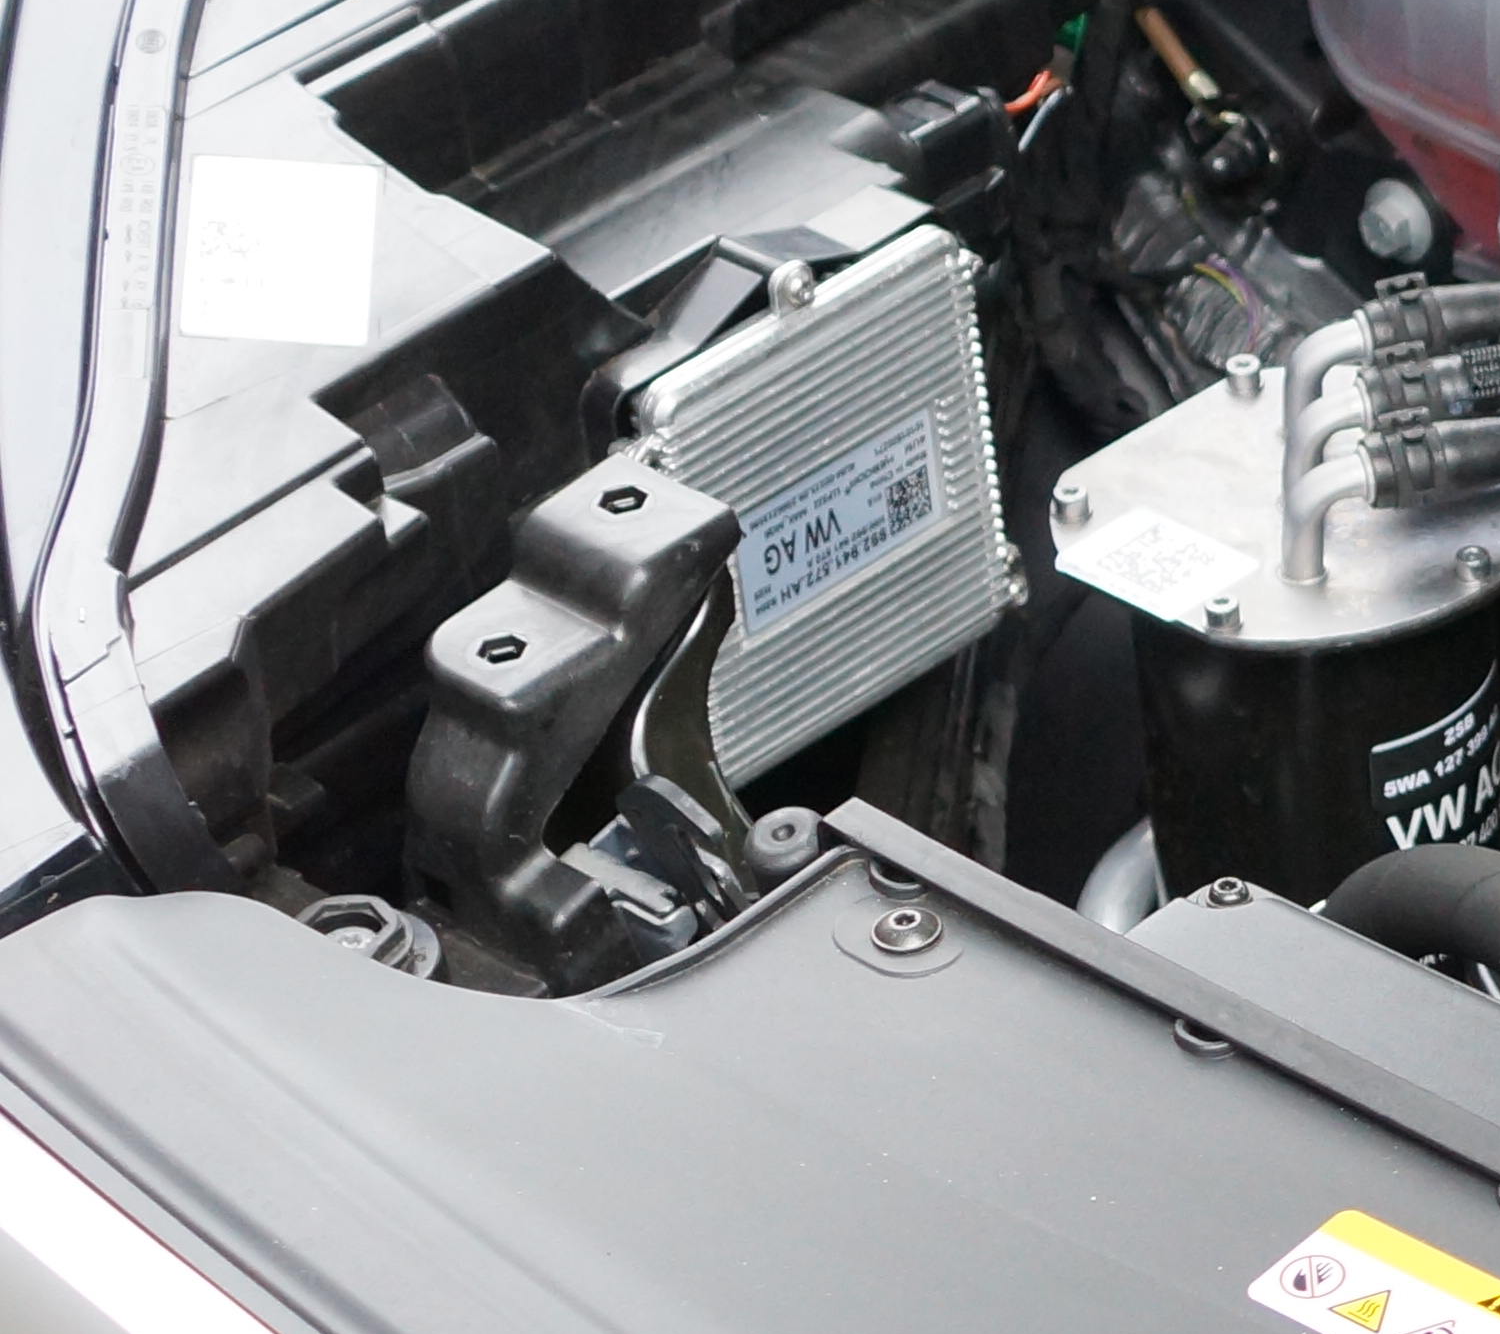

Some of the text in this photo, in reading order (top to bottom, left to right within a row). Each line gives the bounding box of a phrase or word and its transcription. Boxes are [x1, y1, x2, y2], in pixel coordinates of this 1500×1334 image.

[763, 528, 797, 577] AG
[804, 507, 842, 554] VW
[1383, 768, 1432, 799] 5WA
[1434, 746, 1464, 779] 127
[1386, 783, 1468, 851] VW
